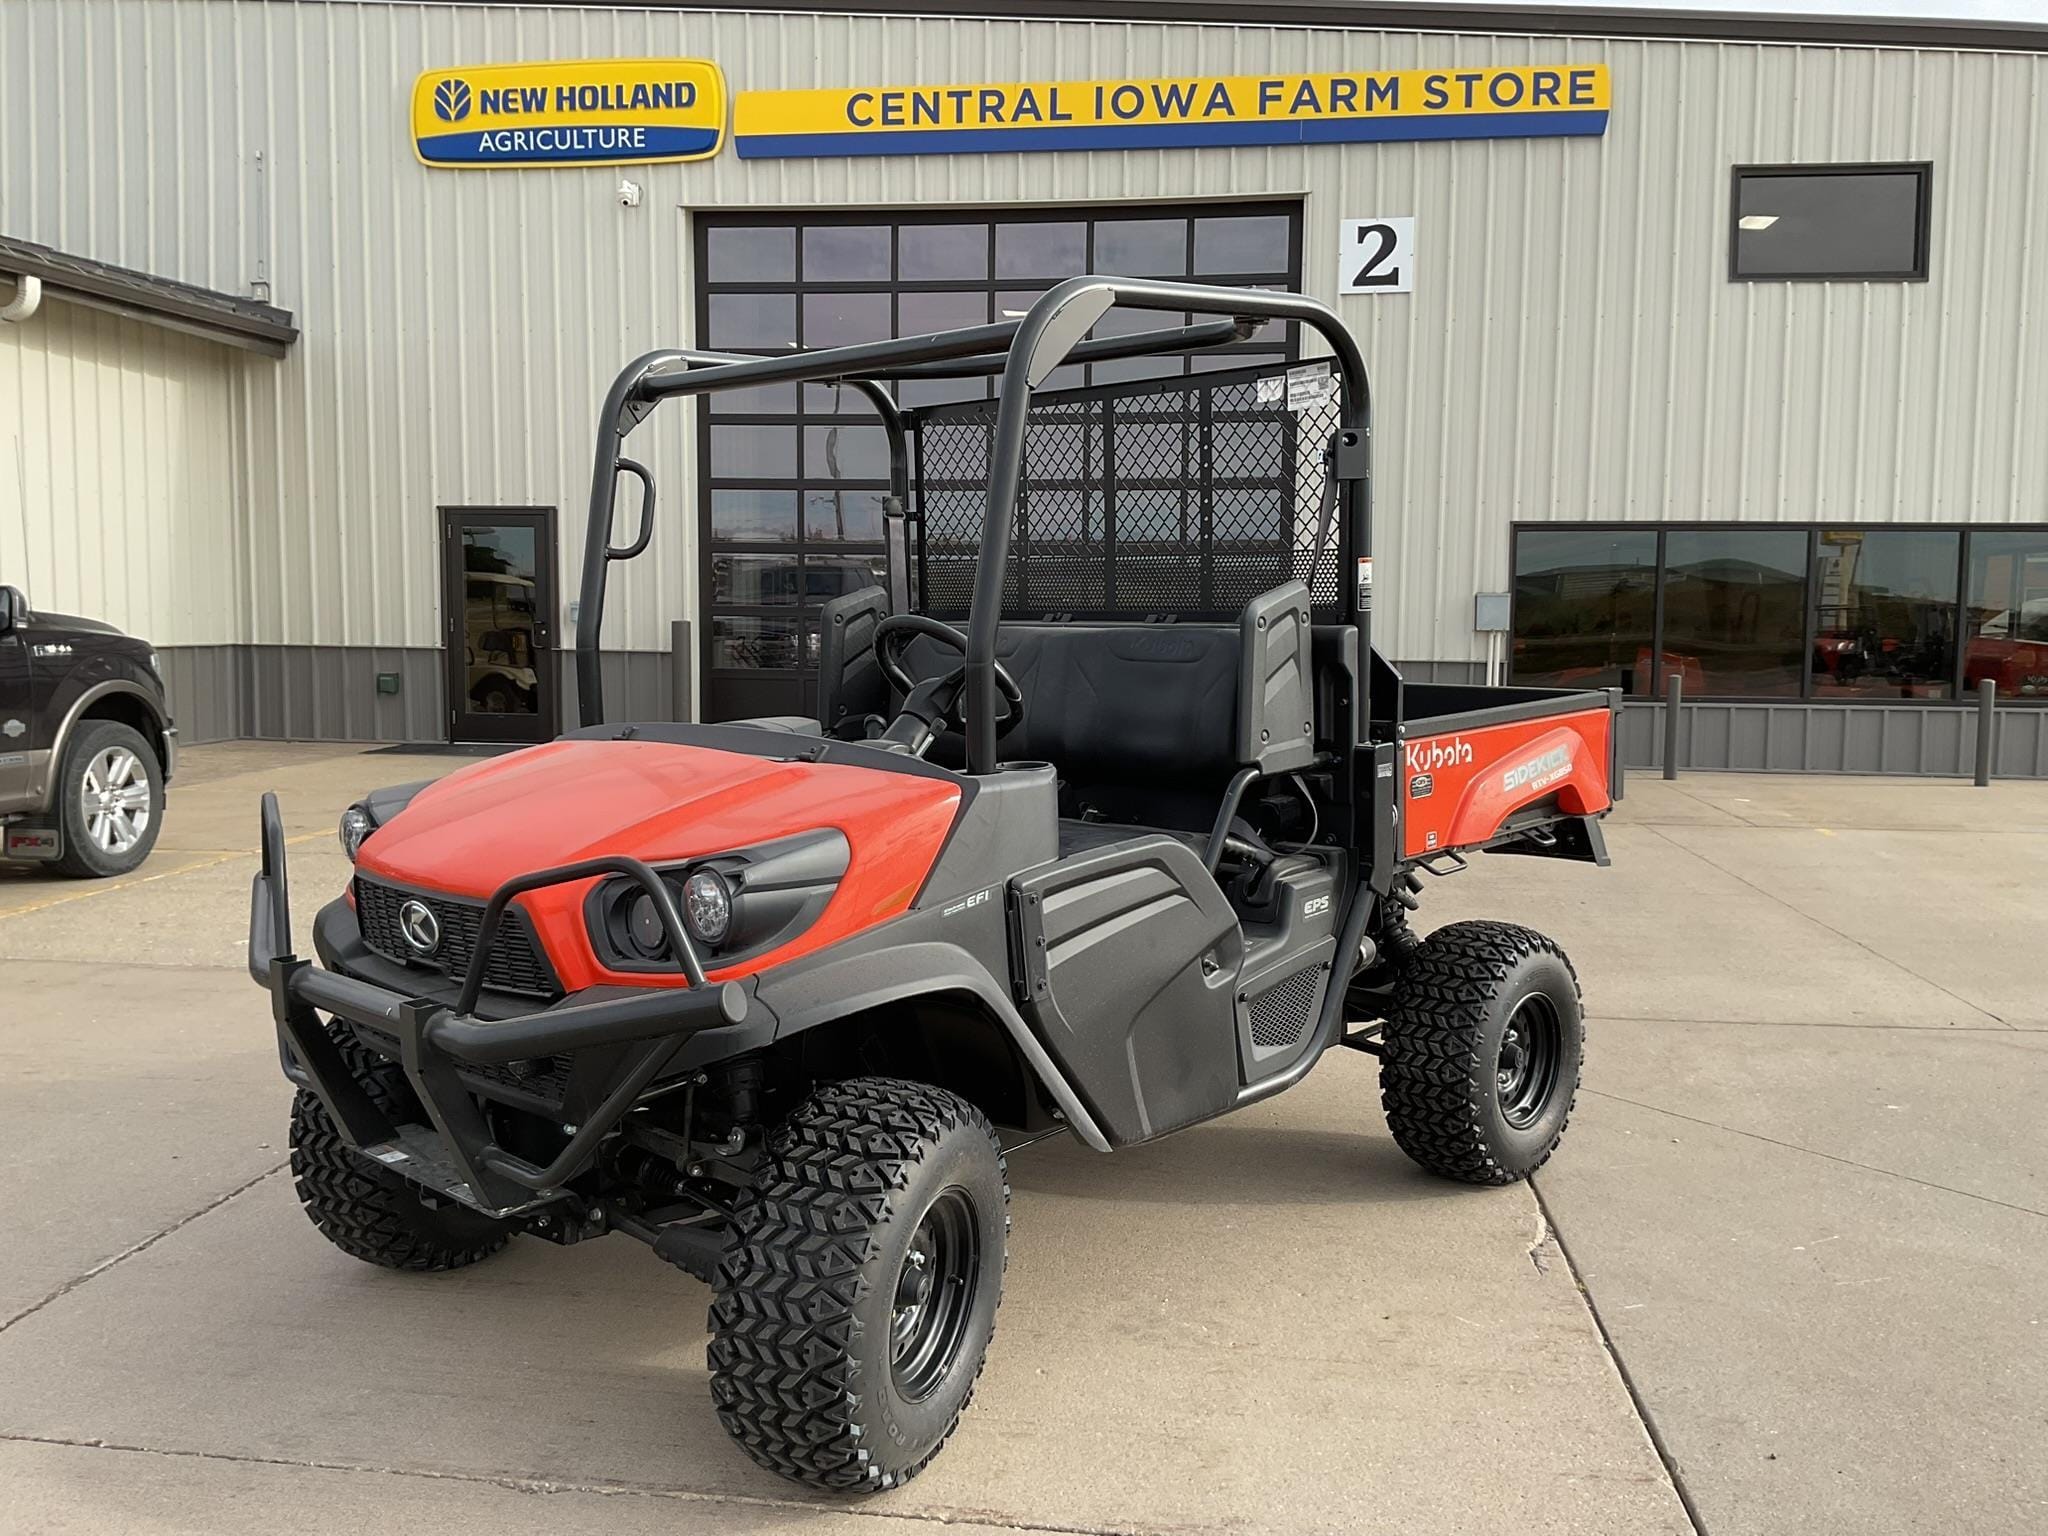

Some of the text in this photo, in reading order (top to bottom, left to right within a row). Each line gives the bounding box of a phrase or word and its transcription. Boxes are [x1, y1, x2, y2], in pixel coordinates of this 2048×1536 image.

[480, 82, 696, 115] NEW HOLLAND
[847, 69, 1596, 127] CENTRAL IOWA FARM STORE
[479, 128, 646, 153] AGRICULTURE
[1352, 223, 1400, 287] 2
[1406, 737, 1473, 773] Kubota
[966, 889, 989, 908] EFI
[1304, 895, 1329, 914] EPS
